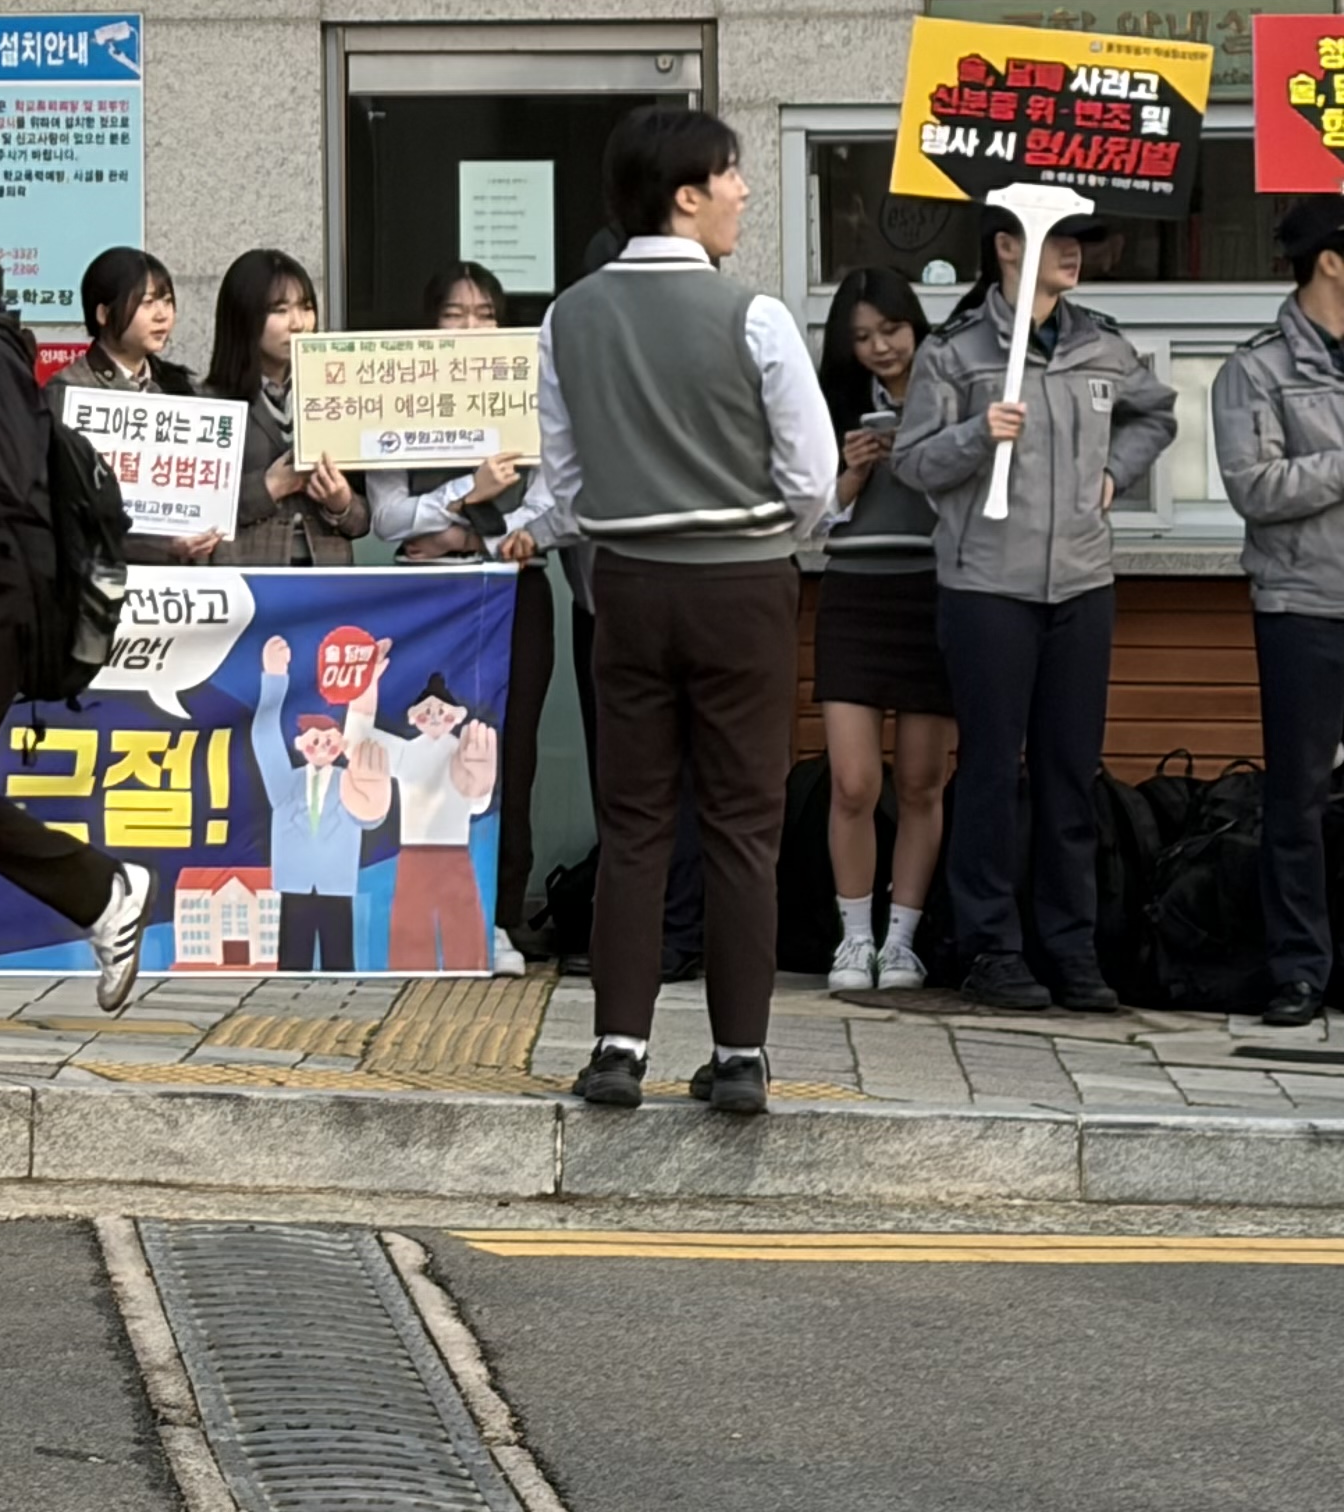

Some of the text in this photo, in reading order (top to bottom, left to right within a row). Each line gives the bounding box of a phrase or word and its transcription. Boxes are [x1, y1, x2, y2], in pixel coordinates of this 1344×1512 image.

[1069, 65, 1160, 101] 사려고
[1288, 72, 1326, 108] 술,
[931, 86, 1019, 121] 신분증
[1140, 105, 1171, 136] 및
[920, 122, 1182, 177] 행사 시 형사처벌
[355, 355, 530, 385] 선생님과 친구들을
[303, 393, 384, 421] 존중하며
[394, 392, 456, 419] 예의를
[74, 404, 234, 449] 로그아웃 없는 고통
[150, 454, 231, 491] 성범죄!
[123, 586, 229, 625] 전하고
[322, 664, 368, 689] OUT
